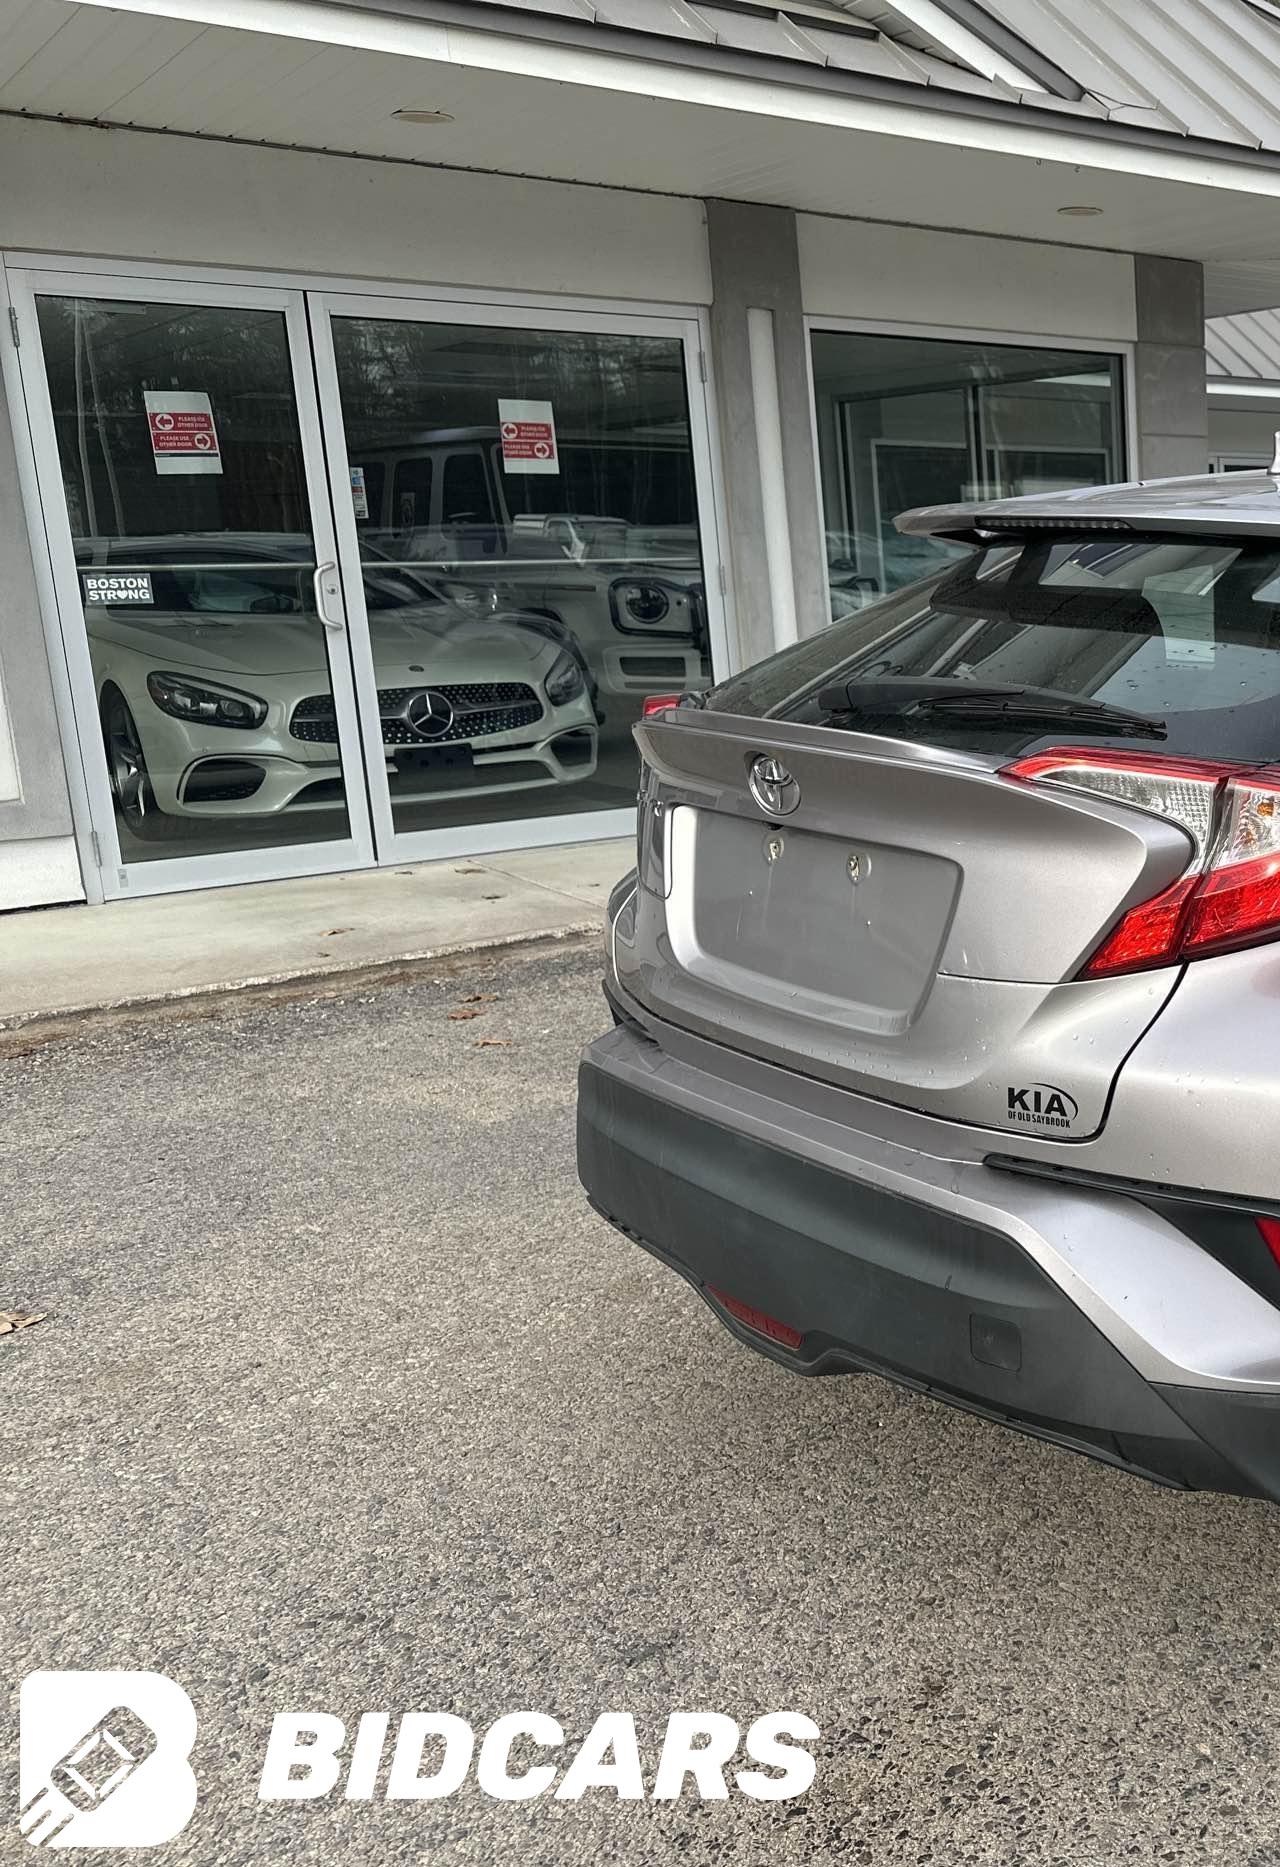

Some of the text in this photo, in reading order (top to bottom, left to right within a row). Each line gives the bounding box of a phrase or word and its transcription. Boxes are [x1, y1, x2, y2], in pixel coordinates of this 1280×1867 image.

[86, 578, 148, 589] BOSTON
[1008, 1087, 1067, 1117] KIA
[1008, 1110, 1071, 1129] OF OLD SAYBROOK
